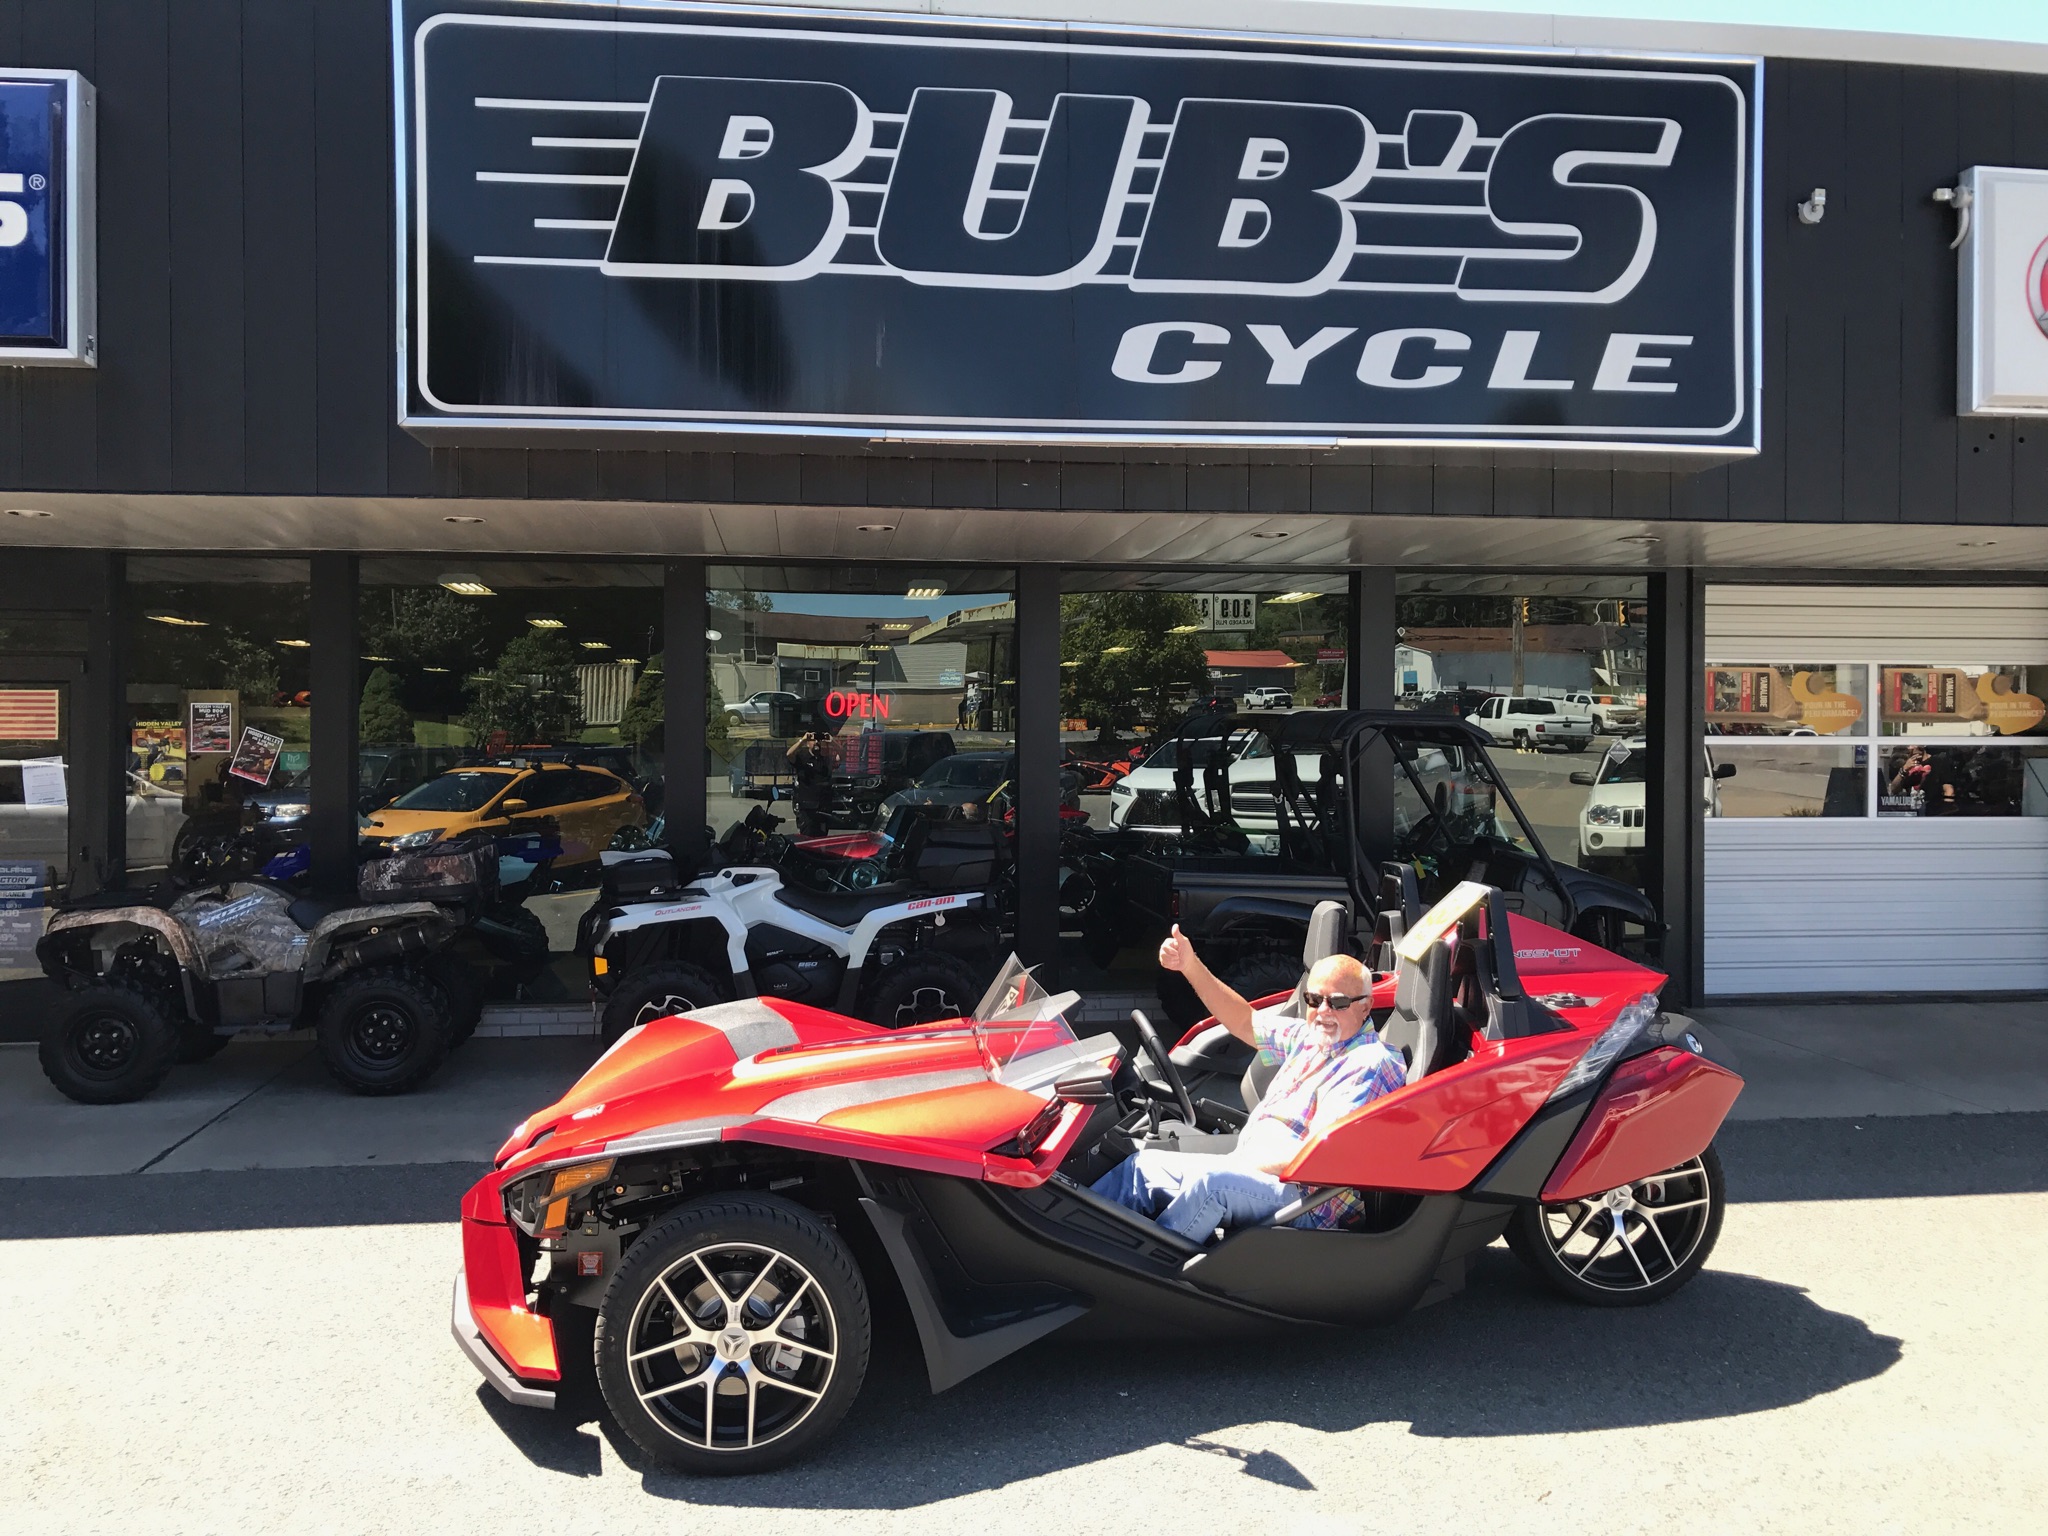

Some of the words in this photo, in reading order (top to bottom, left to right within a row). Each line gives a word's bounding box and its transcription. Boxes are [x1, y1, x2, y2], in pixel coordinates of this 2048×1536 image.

[603, 75, 1682, 305] BUB'S
[1110, 321, 1694, 394] CYCLE
[1760, 676, 1768, 708] YAMALUBE
[825, 691, 889, 718] OPEN
[1804, 701, 1823, 709] POUR
[1825, 701, 1833, 709] IN
[1804, 709, 1858, 717] PERFORMANCE!
[263, 735, 280, 744] VALLEY
[908, 896, 955, 910] can-am
